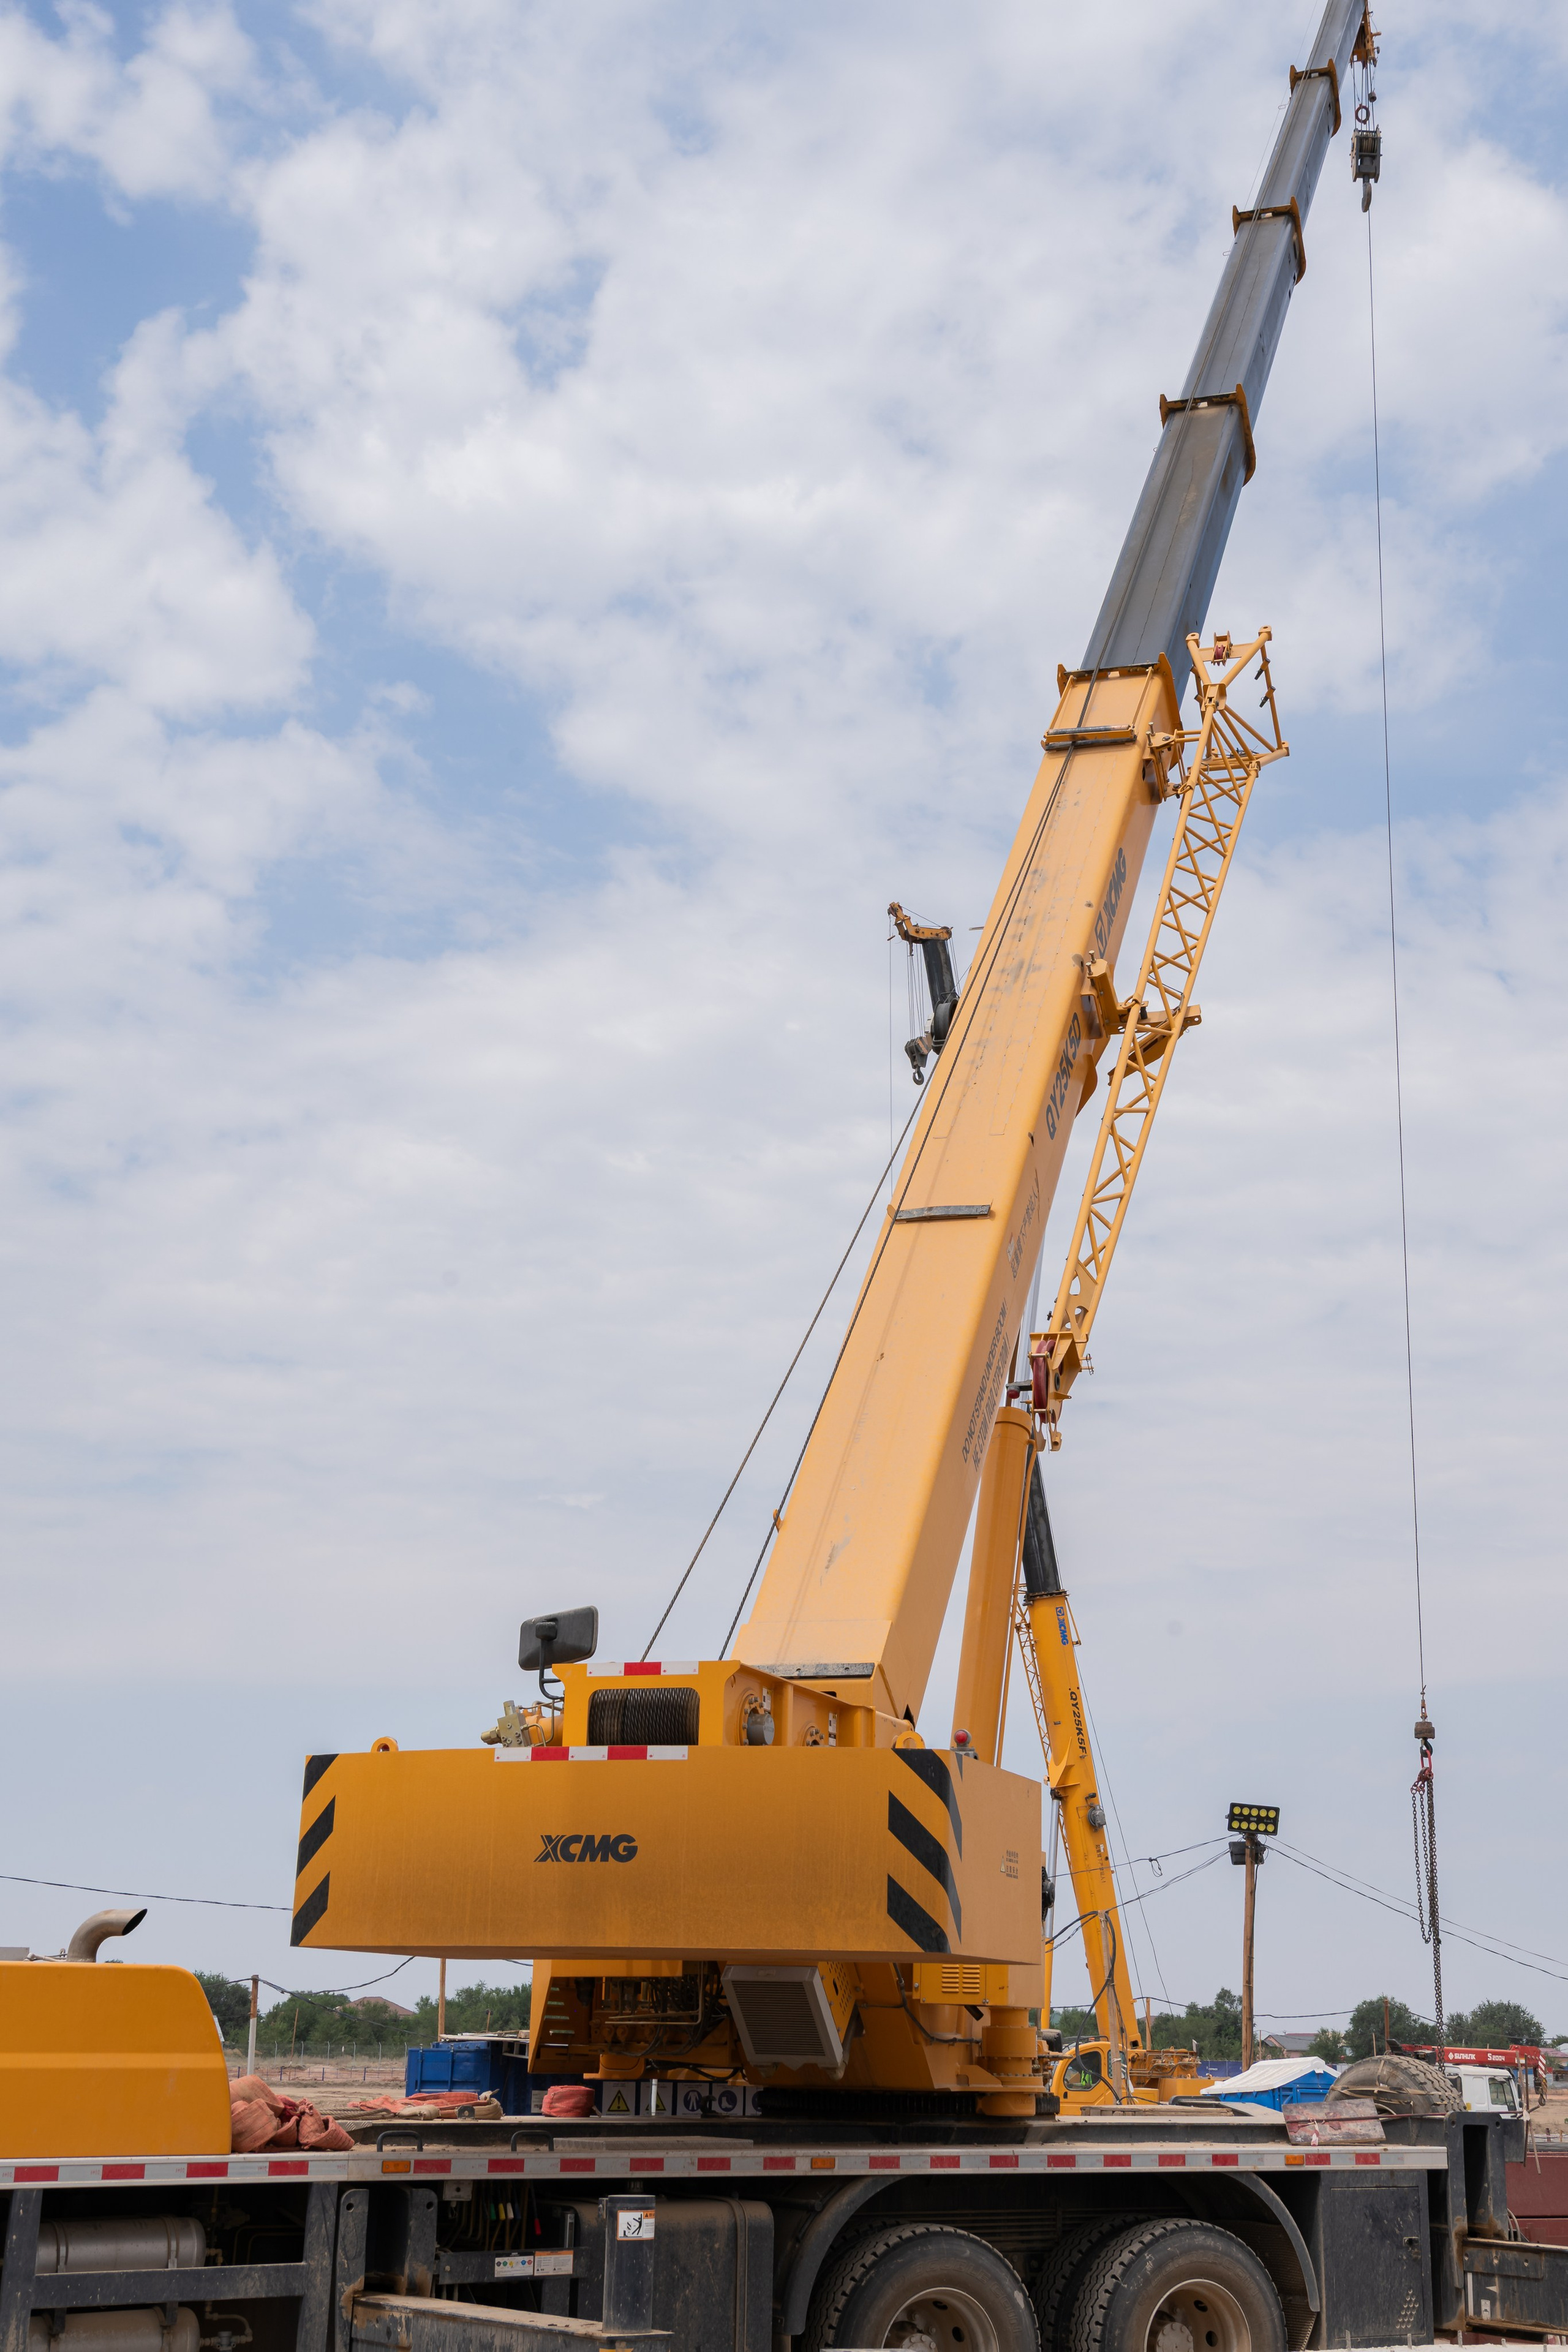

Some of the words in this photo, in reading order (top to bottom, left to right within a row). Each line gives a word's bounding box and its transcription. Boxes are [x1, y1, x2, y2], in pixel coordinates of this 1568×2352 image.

[1103, 847, 1126, 940] XCMG
[1046, 1012, 1081, 1140] QY25K5D
[962, 1437, 970, 1464] DO
[967, 1410, 977, 1445] NOT
[974, 1375, 987, 1419] STAND
[984, 1336, 997, 1381] UNDER
[985, 1387, 996, 1424] ПОД
[976, 1410, 989, 1454] СТОЙ
[972, 1443, 981, 1472] НЕ
[1057, 1616, 1069, 1646] XCMG
[1070, 1691, 1087, 1754] QY25K5F
[533, 1833, 638, 1863] XCMG
